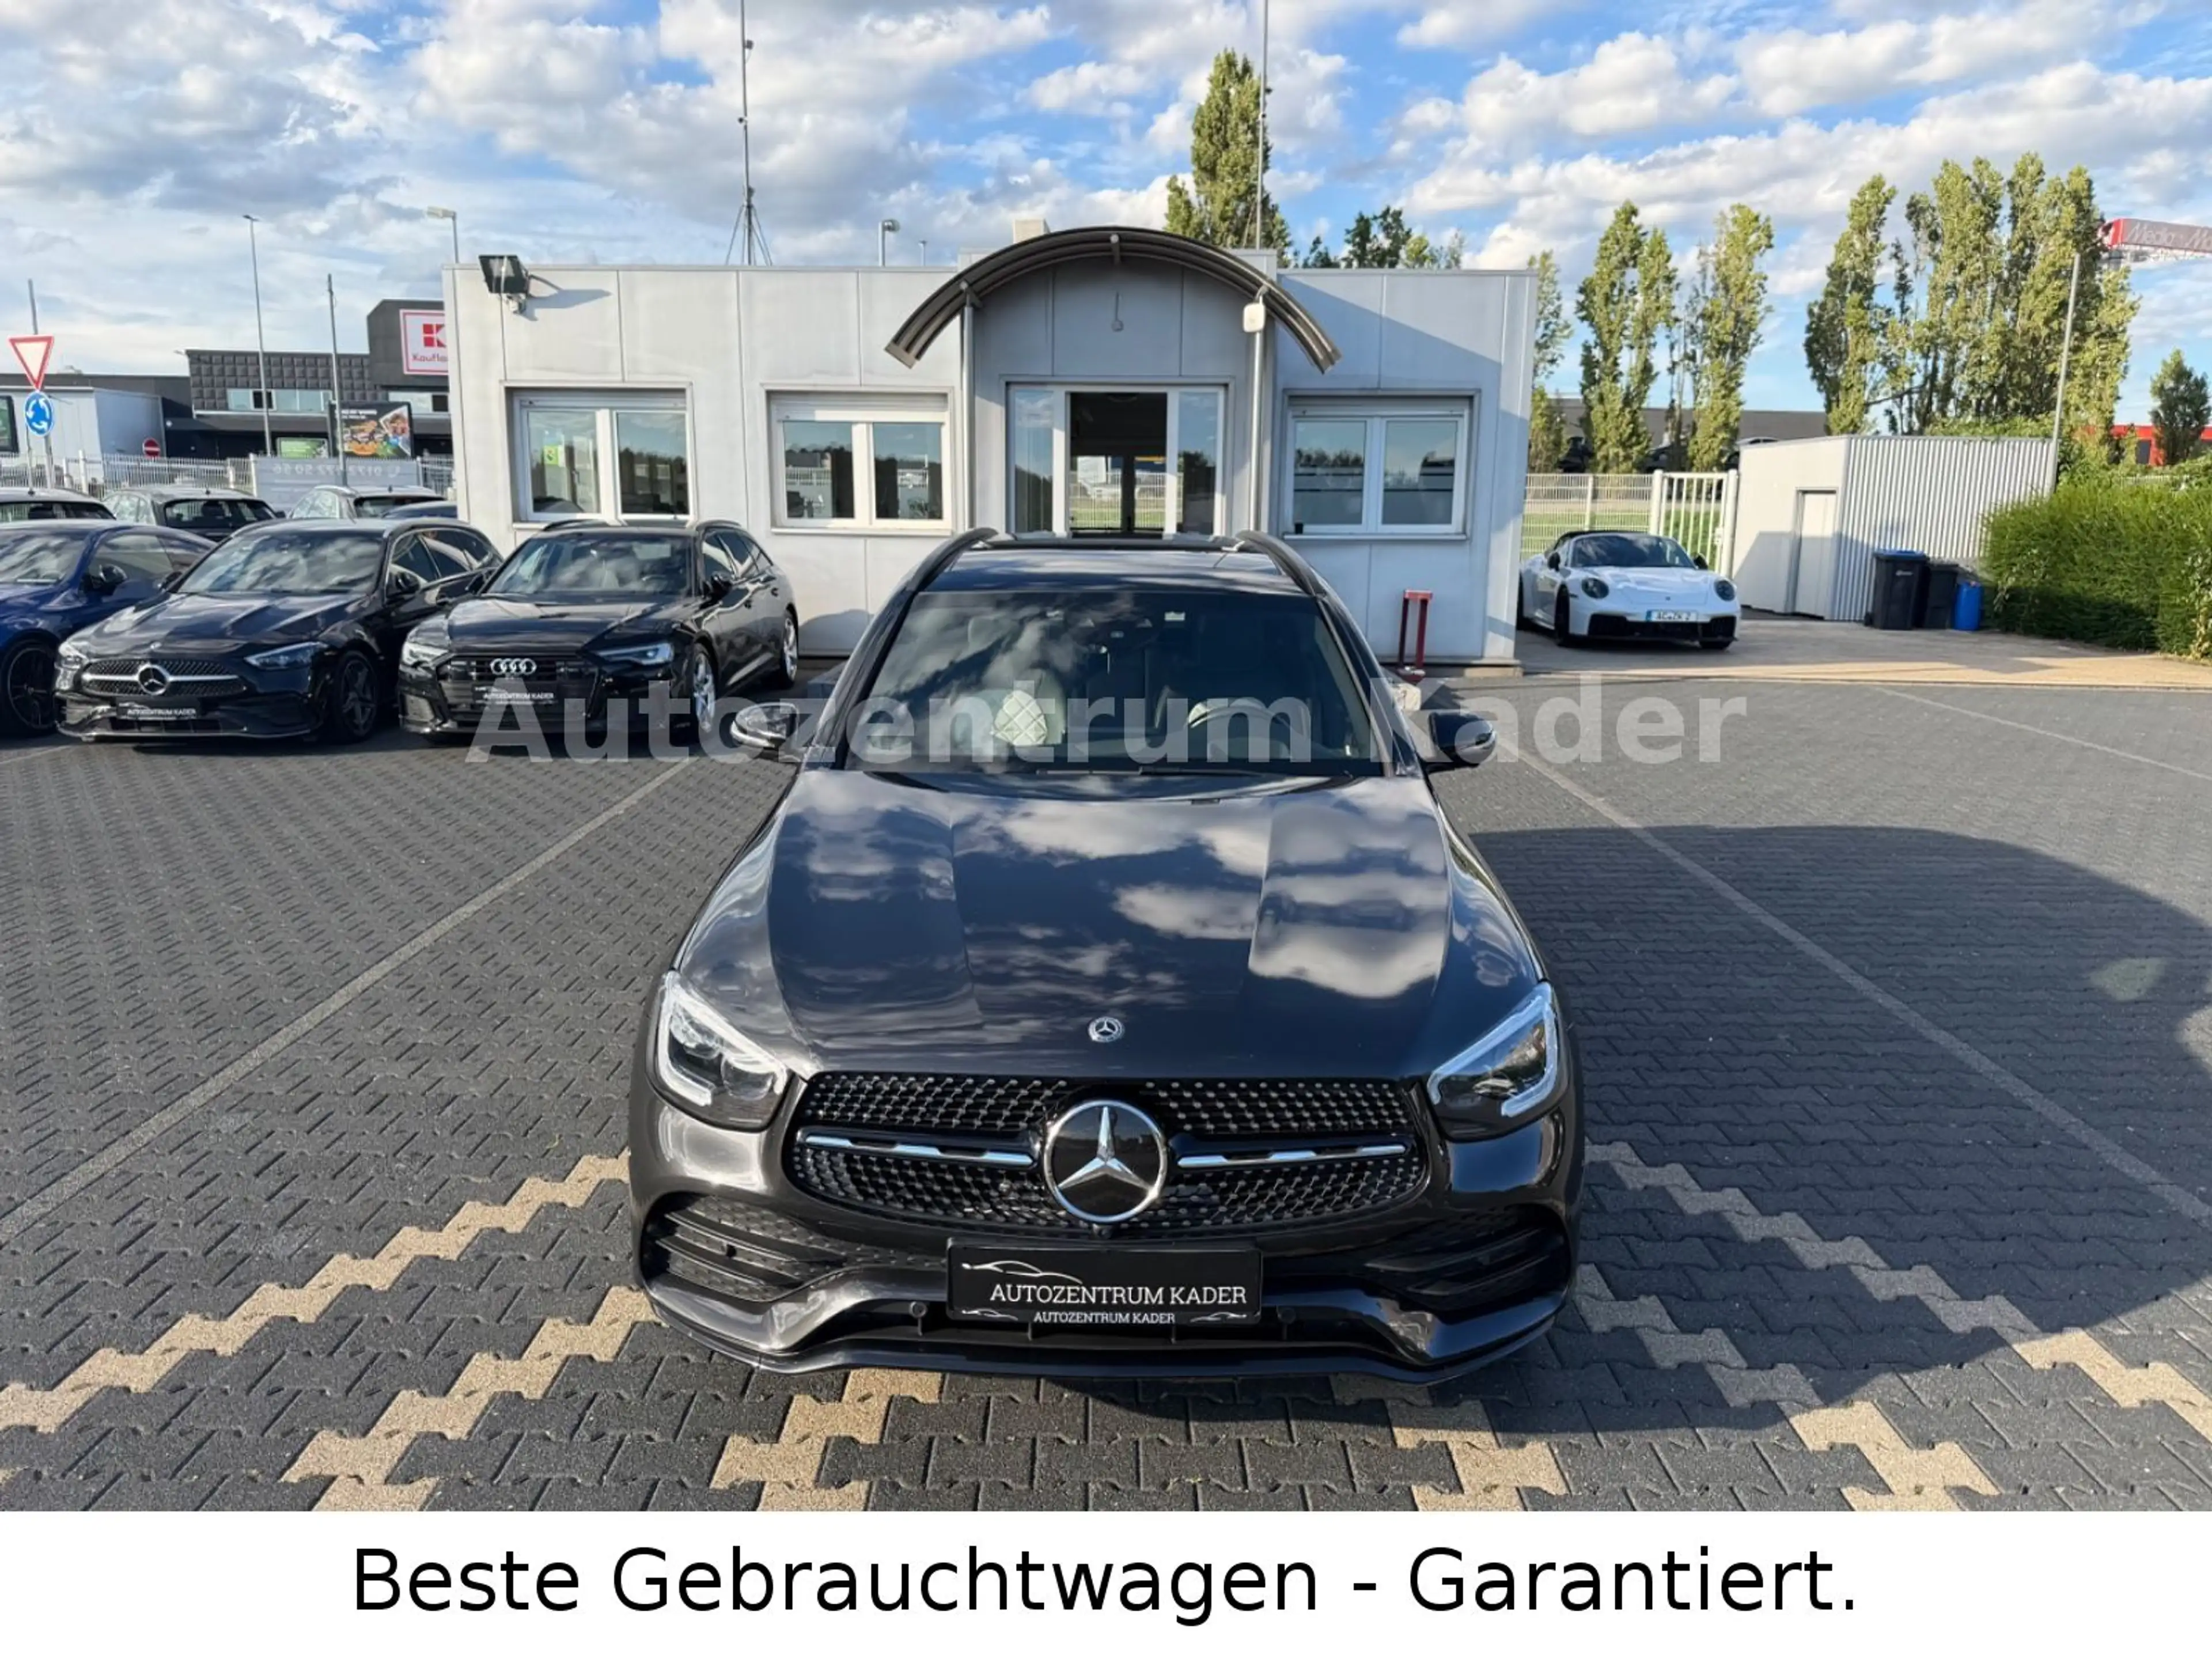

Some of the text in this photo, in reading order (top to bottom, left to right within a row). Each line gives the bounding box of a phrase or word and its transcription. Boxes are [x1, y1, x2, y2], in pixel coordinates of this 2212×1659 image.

[990, 1283, 1247, 1305] AUTOZENTRUM KADER
[1033, 1311, 1175, 1324] AUTOZENTRUM KADER
